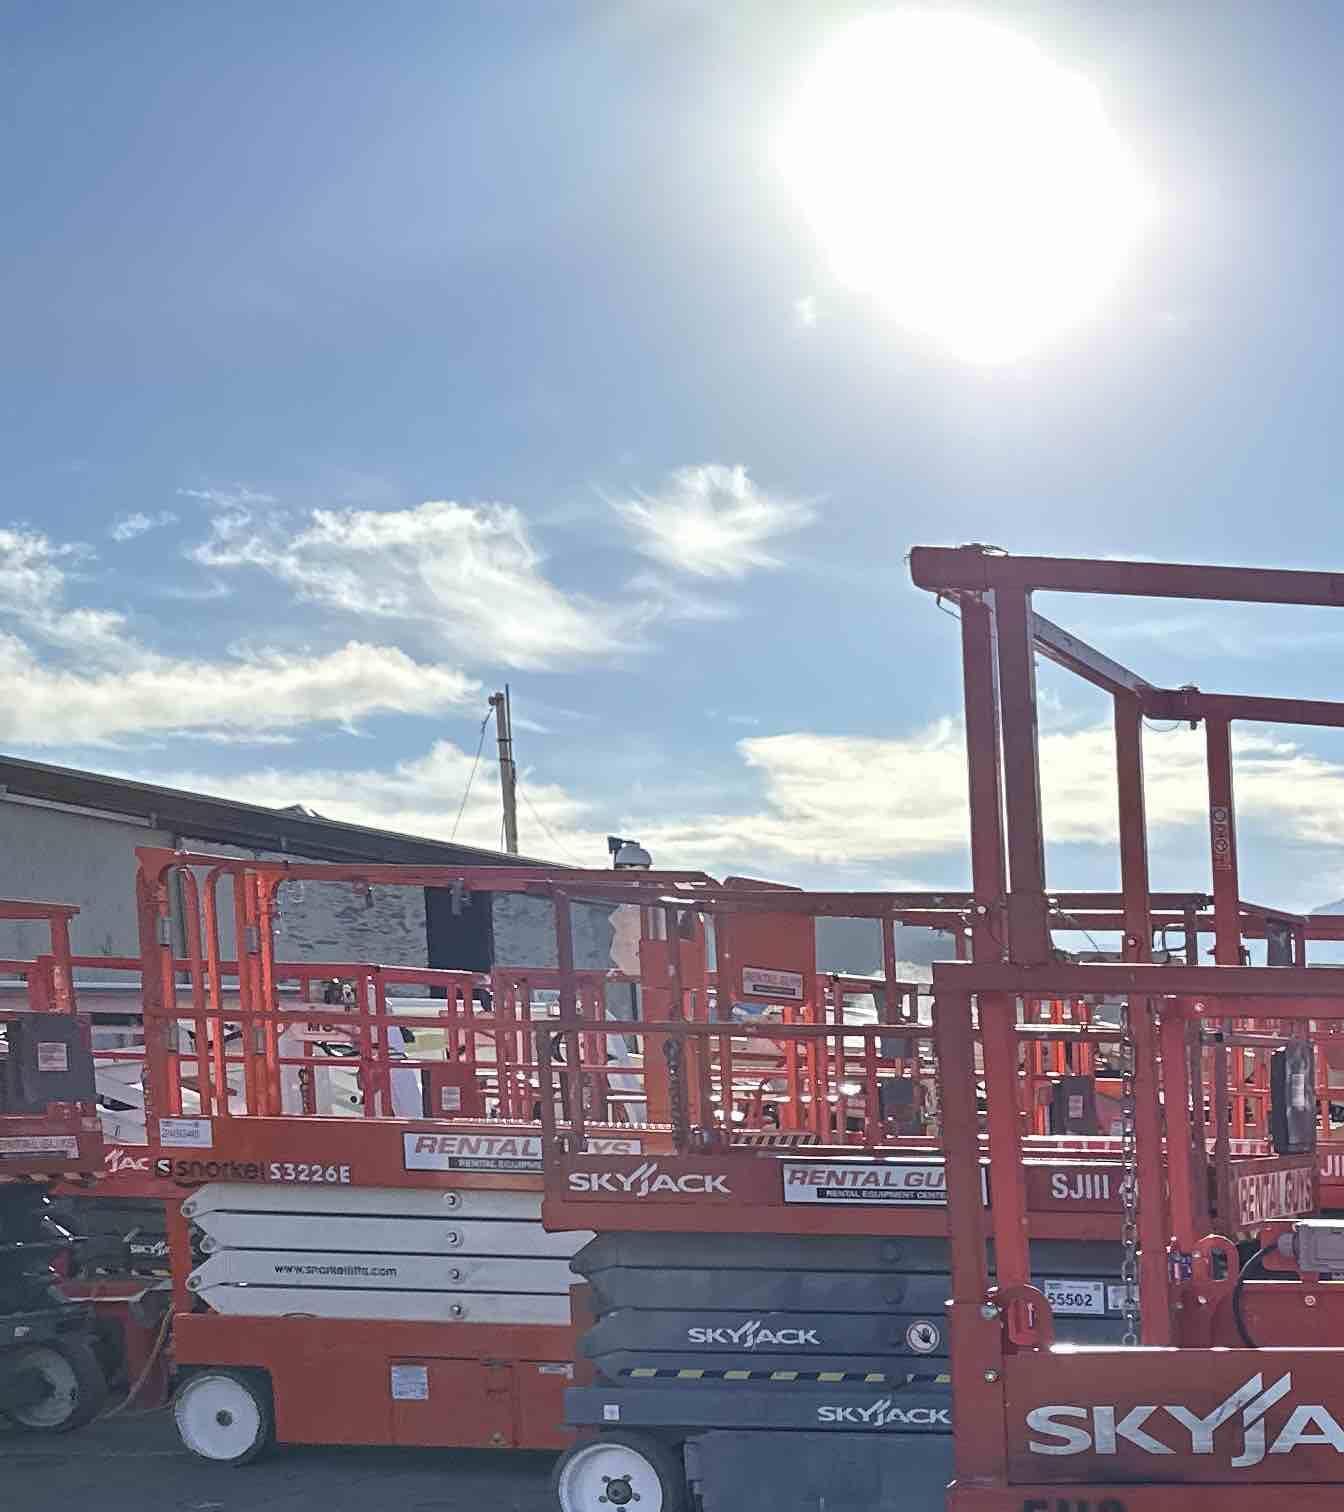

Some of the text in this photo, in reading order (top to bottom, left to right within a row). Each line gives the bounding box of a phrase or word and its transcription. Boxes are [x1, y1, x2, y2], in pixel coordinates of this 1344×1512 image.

[415, 1136, 539, 1156] RENTAL
[270, 1163, 351, 1183] S3226E
[567, 1162, 732, 1197] SKYJACK
[789, 1169, 947, 1188] RENTAL GU
[1051, 1173, 1110, 1199] SJIII
[687, 1320, 822, 1348] SKYJACK
[817, 1400, 951, 1427] SKYJACK
